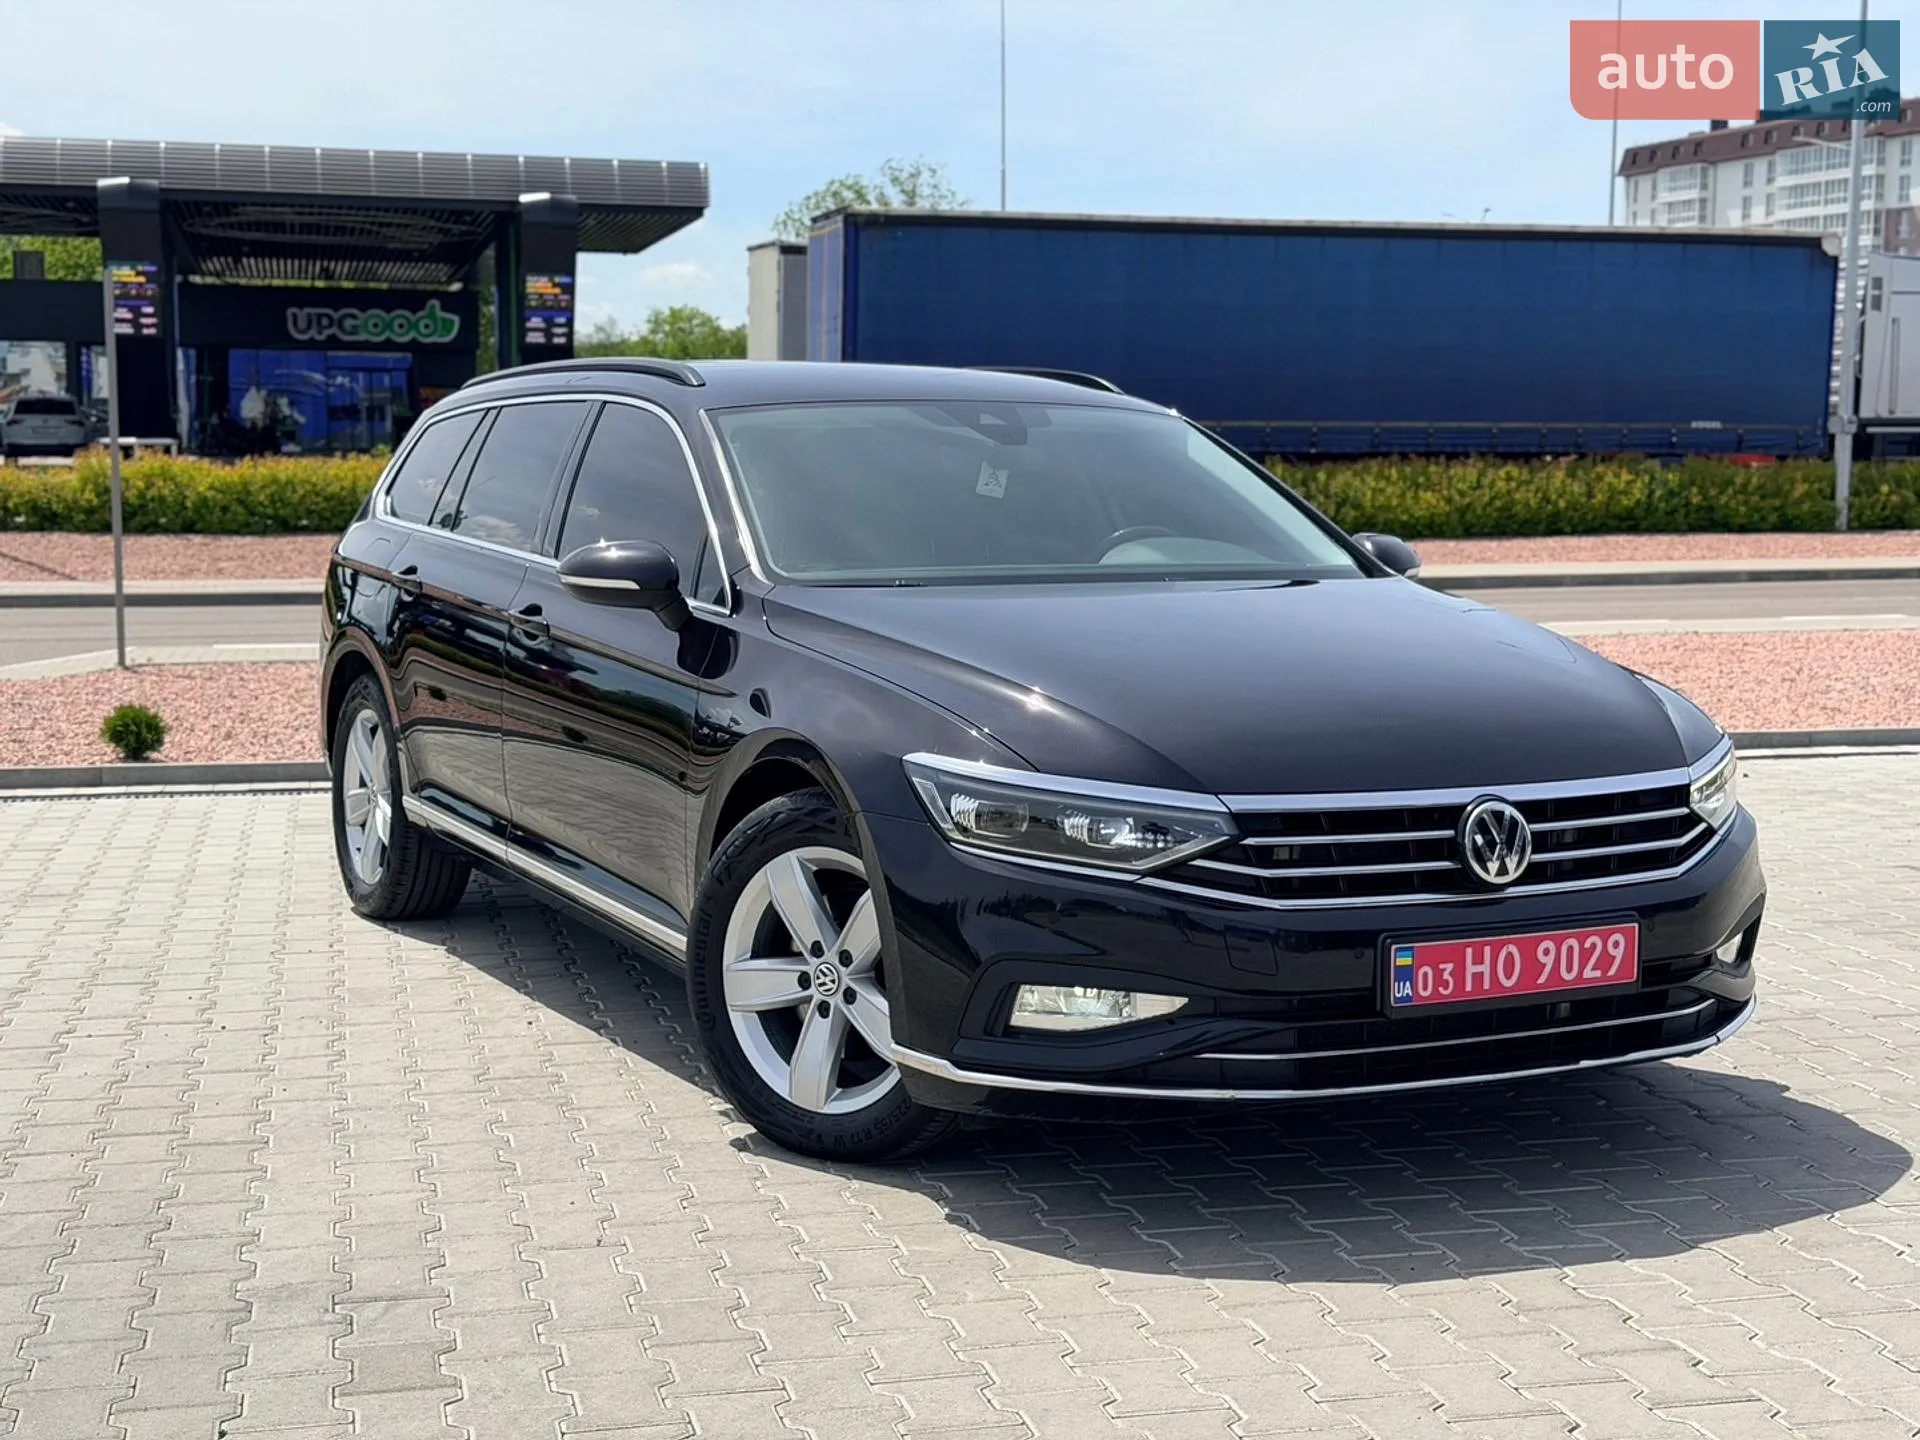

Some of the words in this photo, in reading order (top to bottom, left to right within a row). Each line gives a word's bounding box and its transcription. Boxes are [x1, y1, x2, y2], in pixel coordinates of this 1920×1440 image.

[1418, 963, 1454, 996] 03
[1465, 944, 1521, 991] HO
[1536, 933, 1625, 984] 9029
[1395, 981, 1412, 998] UA
